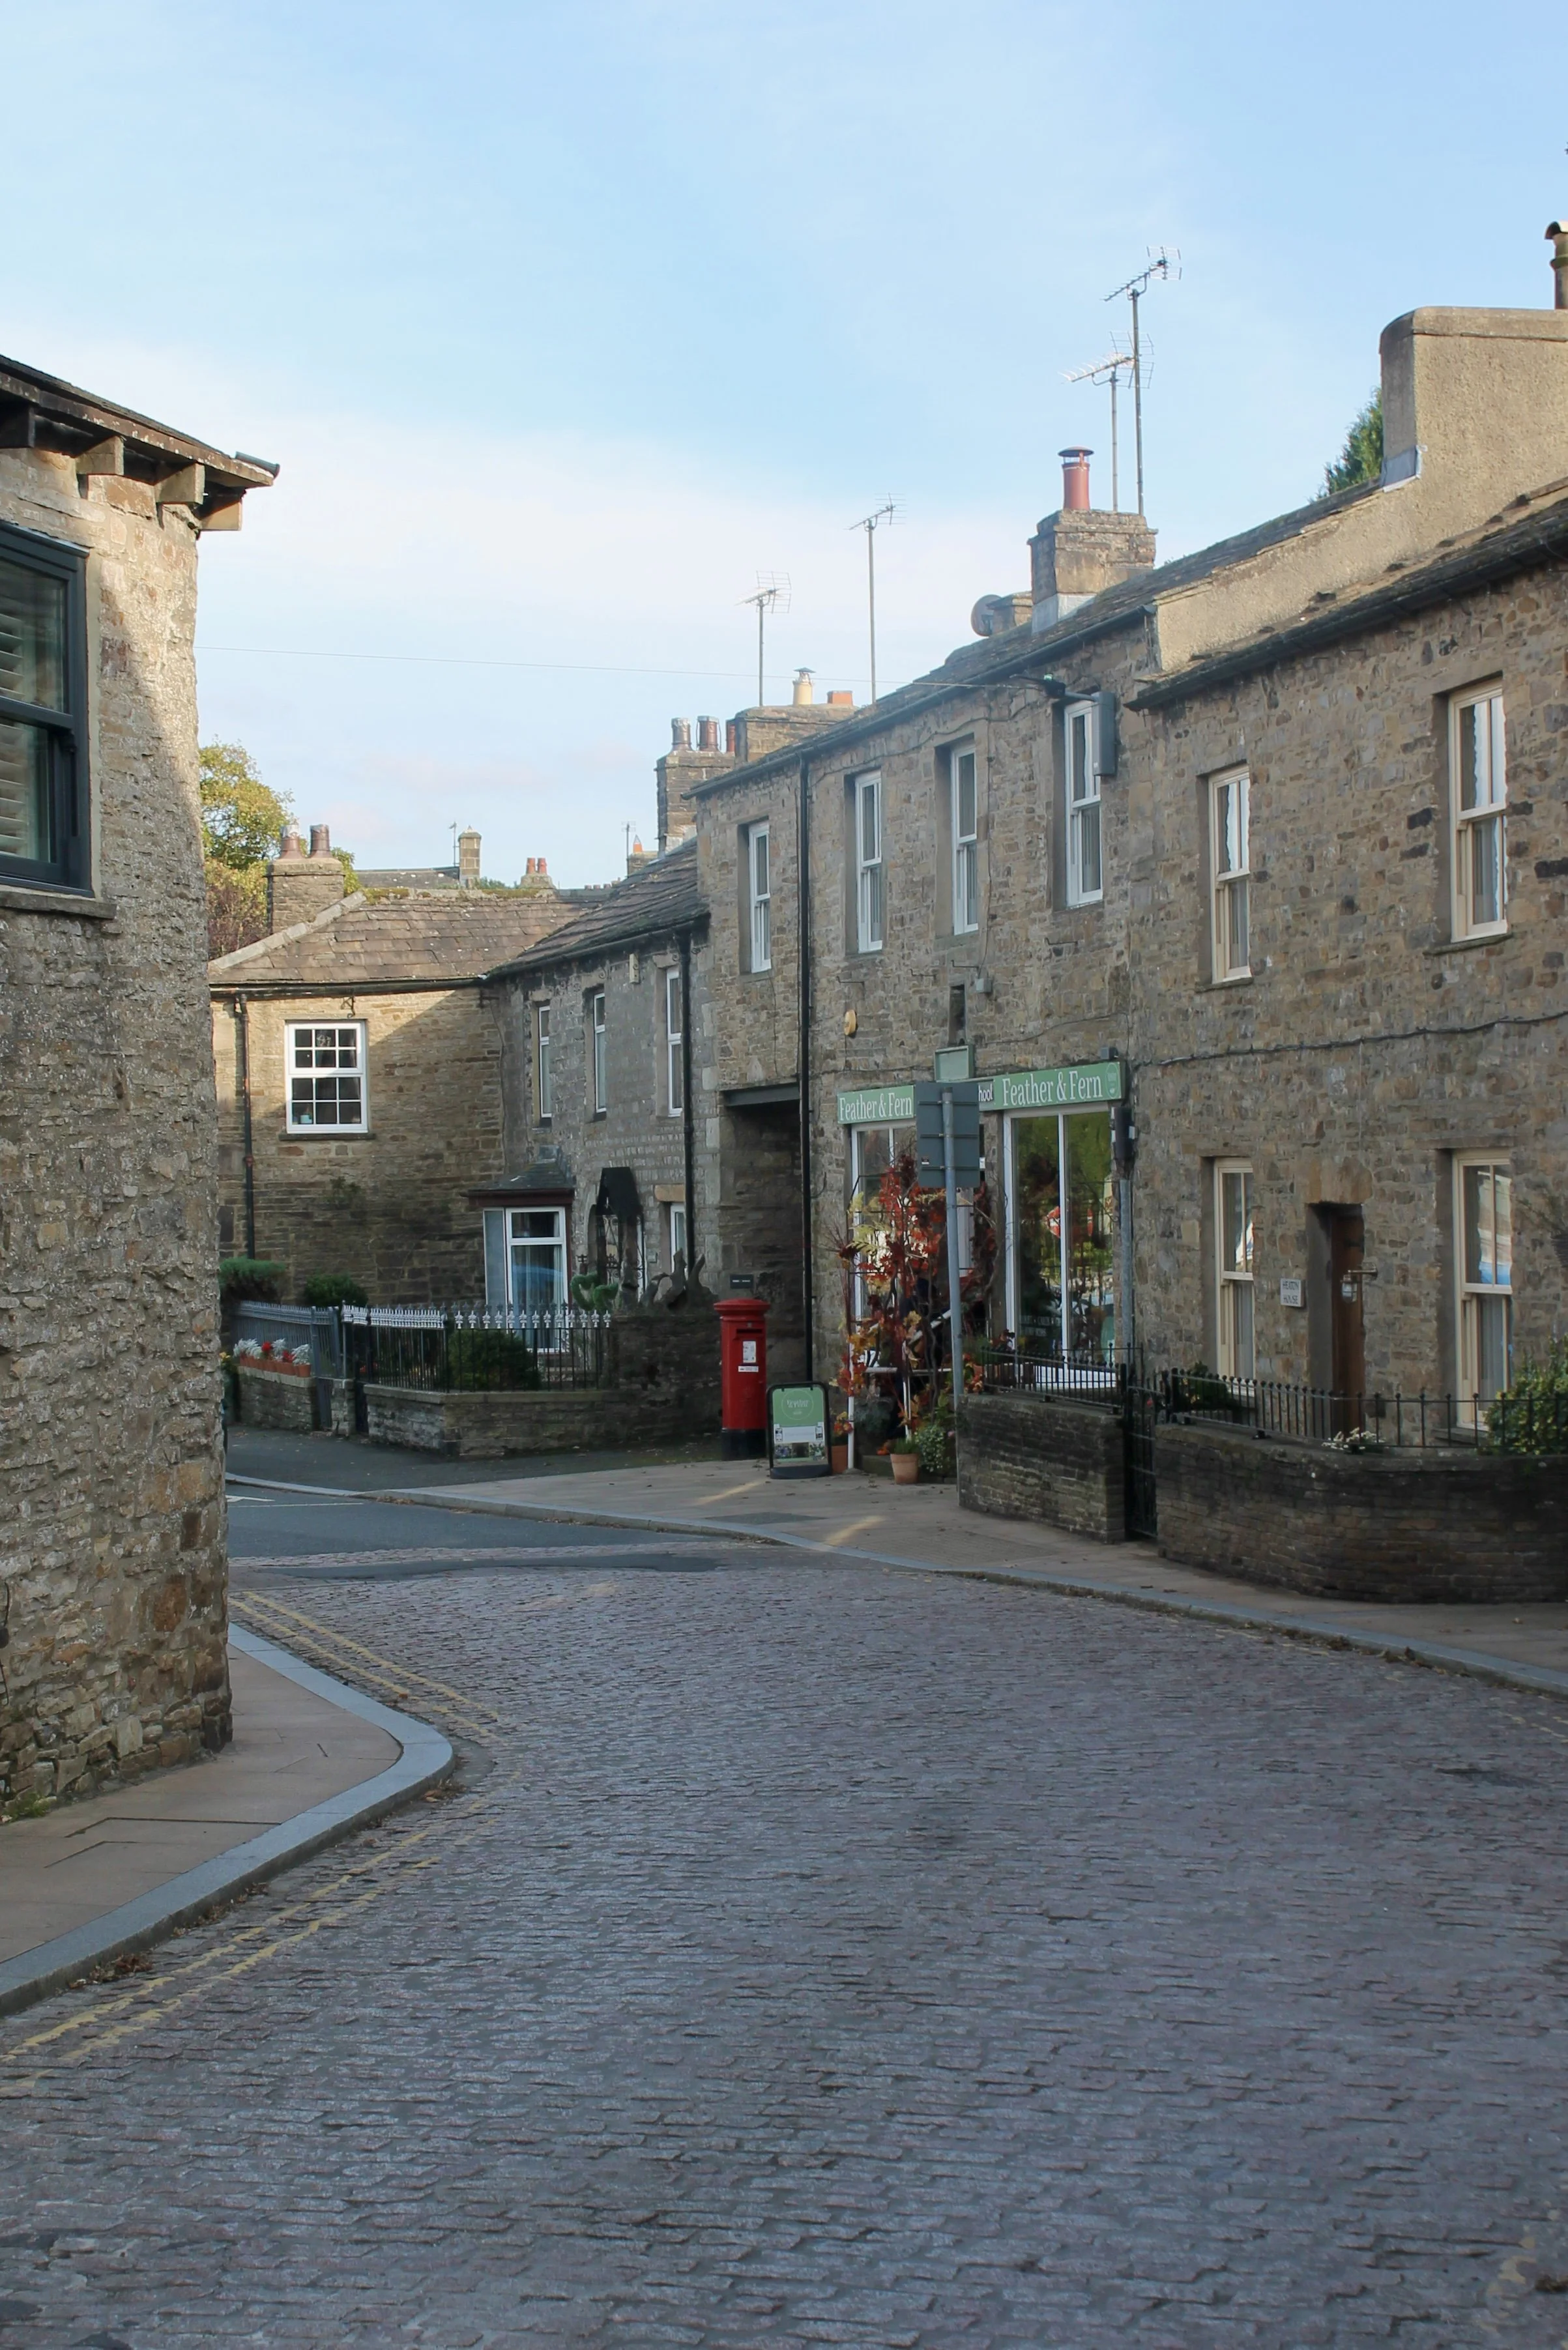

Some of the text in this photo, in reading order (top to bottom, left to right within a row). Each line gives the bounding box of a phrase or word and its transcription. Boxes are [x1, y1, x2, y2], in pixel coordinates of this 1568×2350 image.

[978, 1083, 993, 1102] hool
[1002, 1070, 1103, 1106] Feather & Fern
[839, 1092, 913, 1121] Feather & Fern
